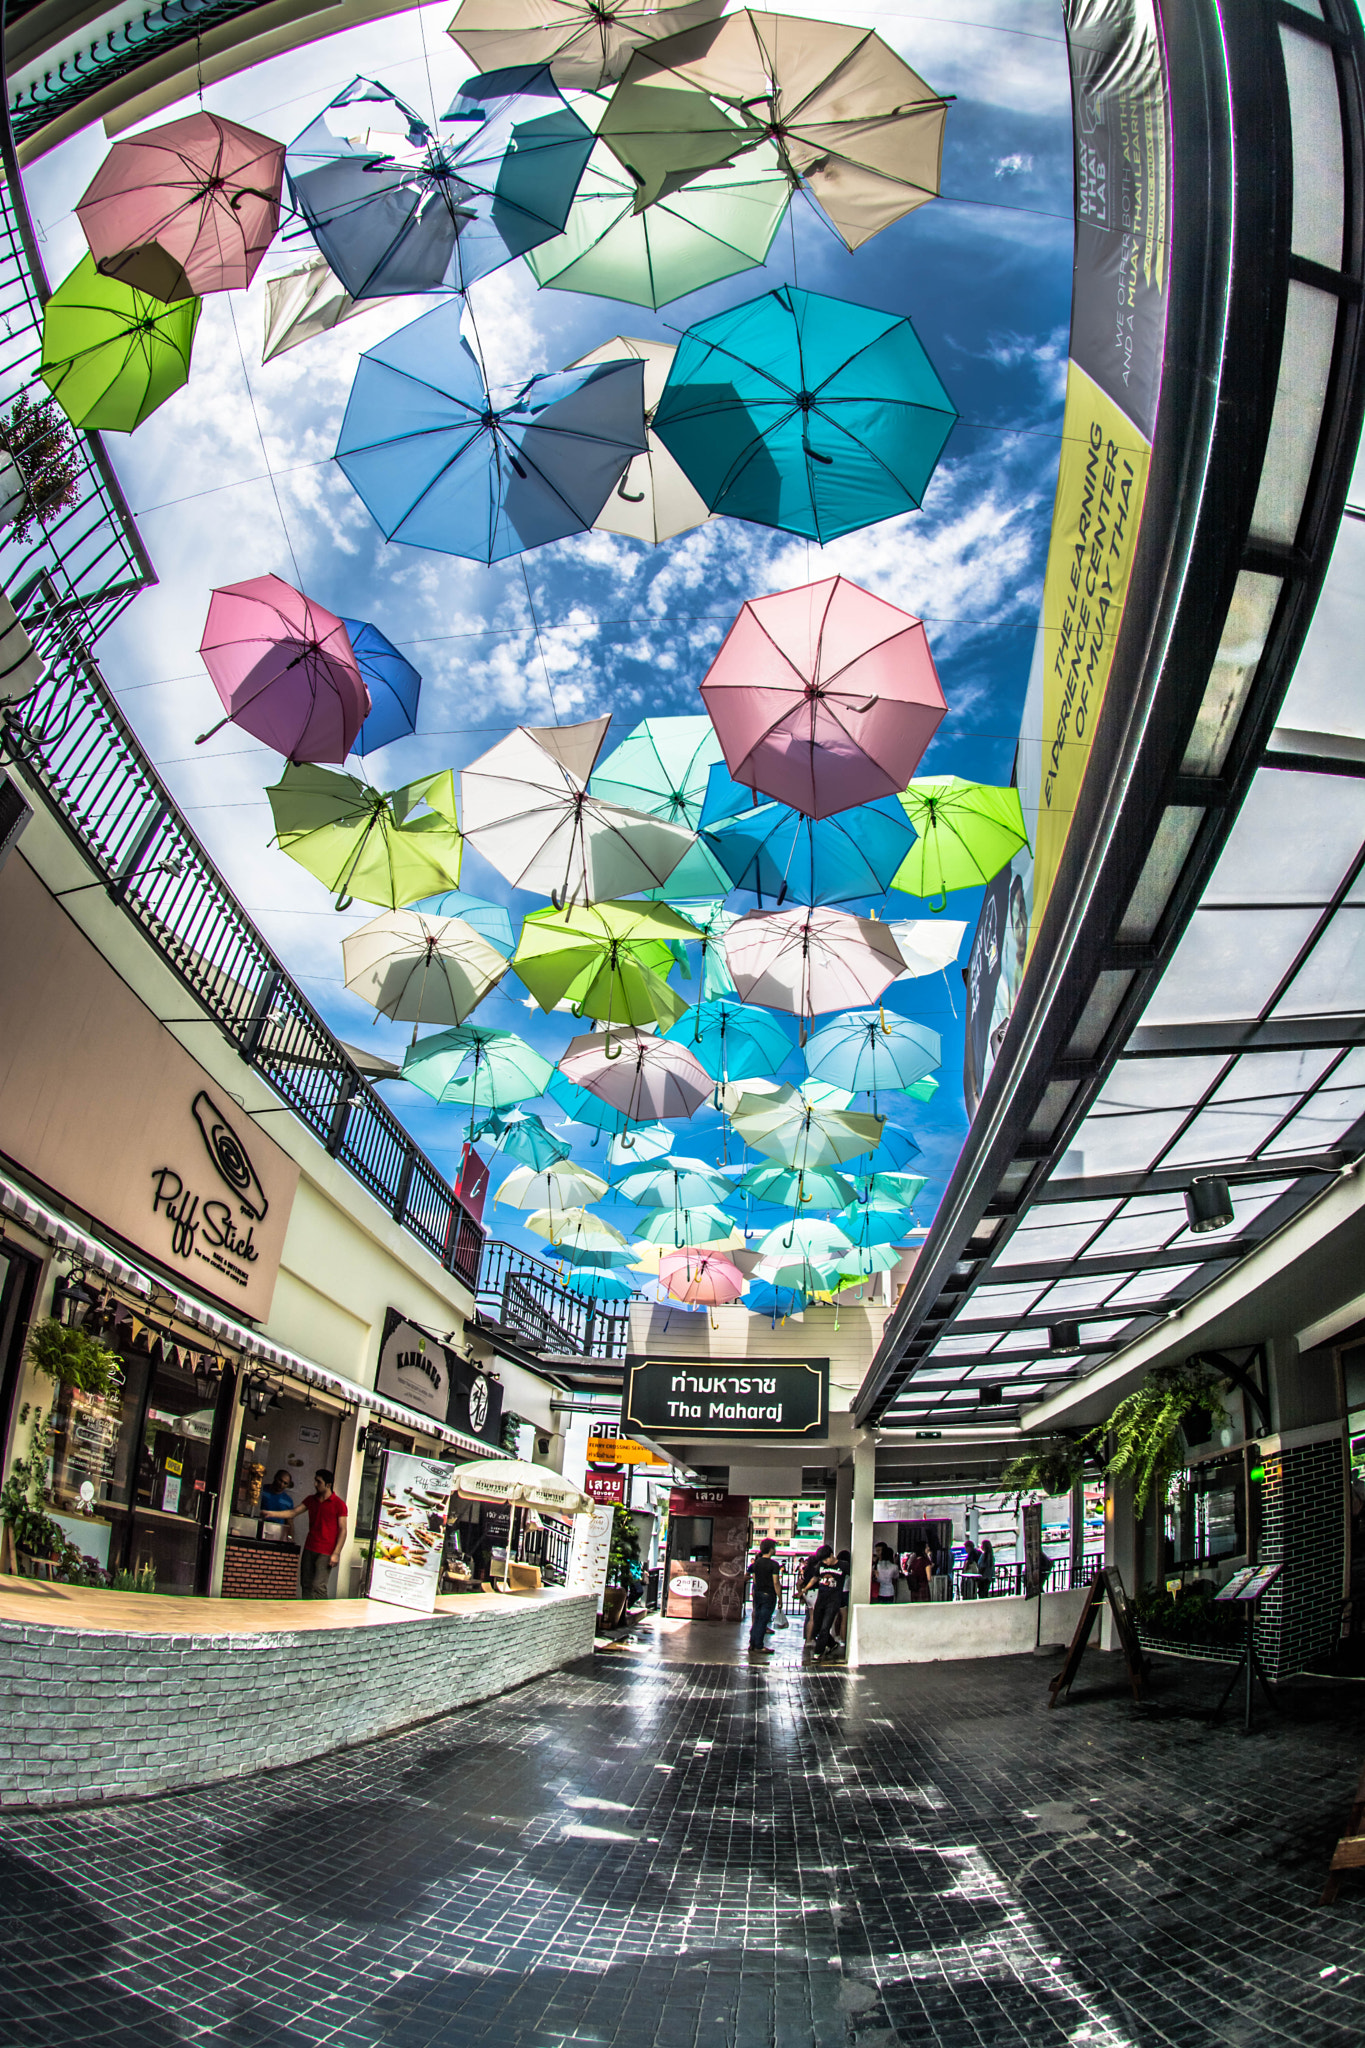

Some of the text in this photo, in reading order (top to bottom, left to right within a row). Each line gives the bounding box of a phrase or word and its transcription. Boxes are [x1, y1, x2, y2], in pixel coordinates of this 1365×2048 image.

[1079, 138, 1088, 214] MUAY
[1088, 148, 1096, 216] THAI
[1097, 162, 1106, 220] LAB
[1122, 167, 1131, 229] BOTH
[1133, 181, 1142, 233] THAI
[1117, 233, 1130, 306] OFFER
[1127, 239, 1140, 308] MUAY
[1115, 311, 1125, 347] WE
[1127, 315, 1134, 332] A
[1122, 336, 1134, 388] AND
[1085, 438, 1119, 598] CENTER
[1054, 421, 1103, 680] THE LEARNING
[1075, 459, 1134, 739] OF MUAY THAI
[151, 1166, 259, 1262] Puff Stick
[671, 1370, 777, 1394] ท่ามหาราช
[667, 1401, 783, 1423] Tha Maharaj
[588, 1479, 621, 1491] เสวย
[695, 1491, 724, 1502] เสวย
[676, 1579, 691, 1587] 2nd
